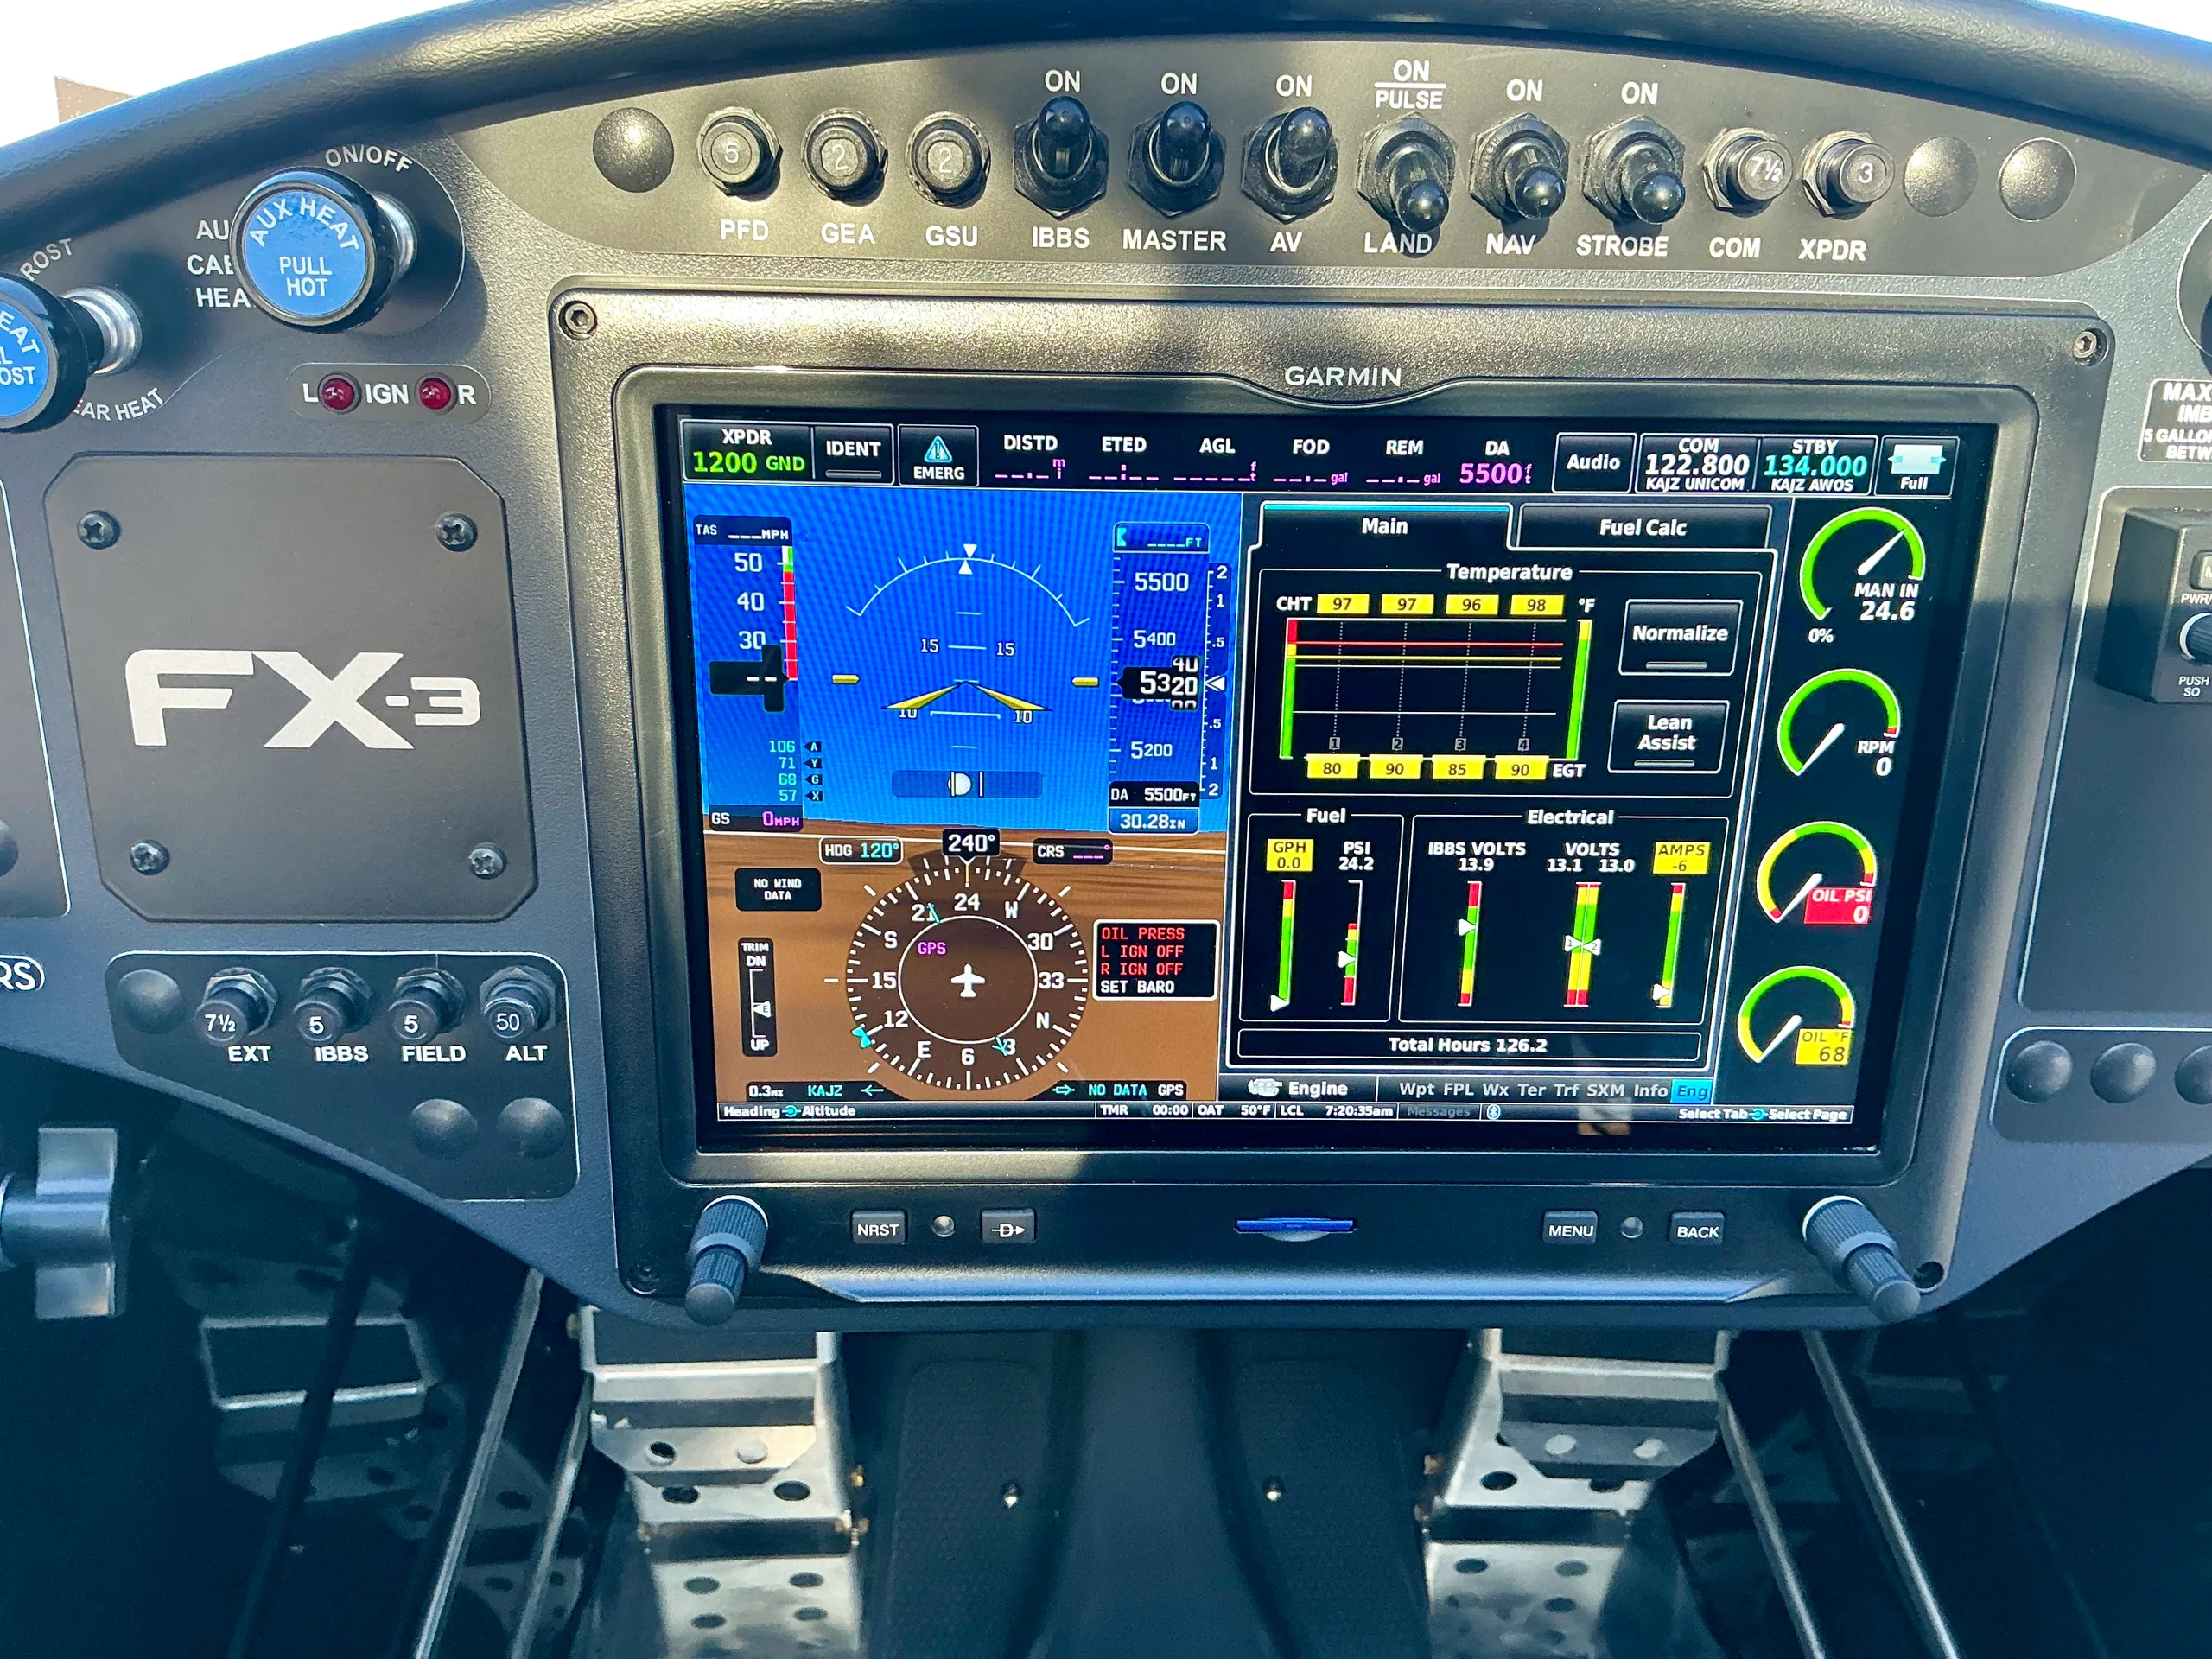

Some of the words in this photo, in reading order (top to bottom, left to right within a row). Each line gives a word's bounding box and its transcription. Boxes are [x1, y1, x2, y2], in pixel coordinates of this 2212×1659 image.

[1393, 60, 1431, 81] ON
[1045, 70, 1081, 92] ON
[1160, 73, 1198, 95] ON
[1275, 75, 1313, 97] ON
[1506, 79, 1543, 102] ON
[1621, 83, 1658, 105] ON
[1375, 90, 1443, 111] PULSE
[325, 145, 413, 173] ON/OFF
[724, 140, 740, 163] 5
[833, 146, 849, 171] 2
[1857, 162, 1874, 183] 3
[249, 198, 293, 247] AUX
[299, 197, 359, 251] HEAT
[720, 220, 769, 241] PFD
[821, 223, 875, 245] GEA
[925, 226, 978, 247] GSU
[1032, 227, 1090, 250] IBBS
[1122, 230, 1226, 251] MASTER
[1269, 232, 1303, 252] AV
[1363, 232, 1433, 254] LAND
[1486, 234, 1537, 256] NAV
[1576, 234, 1669, 257] STROBE
[1709, 237, 1761, 258] COM
[1799, 238, 1866, 260] XPDR
[279, 256, 332, 276] PULL
[286, 278, 328, 296] HOT
[1284, 366, 1402, 388] GARMIN
[302, 383, 319, 403] L
[365, 383, 408, 404] IGN
[457, 385, 476, 404] R
[115, 387, 163, 421] HEAT
[2144, 428, 2153, 442] 5
[721, 429, 772, 445] XPDR
[826, 441, 881, 457] IDENT
[1003, 435, 1058, 451] DISTD
[1102, 436, 1147, 452] ETED
[1199, 438, 1235, 454] AGL
[1292, 440, 1330, 454] FOD
[1386, 440, 1424, 454] REM
[1485, 441, 1510, 456] DA
[1678, 438, 1719, 454] COM
[1792, 439, 1839, 454] STBY
[693, 451, 757, 473] 1200
[766, 456, 805, 471] GND
[1567, 454, 1620, 470] Audio
[1645, 454, 1749, 475] 122.800
[1764, 455, 1867, 476] 134.000
[913, 466, 965, 480] EMERG
[1459, 463, 1522, 484] 5500
[1646, 478, 1681, 492] KAJZ
[1685, 478, 1745, 490] UNICOM
[1900, 477, 1928, 490] Full
[696, 524, 717, 535] TAS
[1362, 518, 1408, 534] Main
[1599, 518, 1642, 535] Fuel
[1646, 519, 1687, 536] Calc
[734, 553, 763, 572] 50
[1446, 563, 1573, 584] Temperature
[1854, 583, 1895, 597] MAN
[1900, 583, 1918, 598] IN
[1276, 596, 1312, 610] CHT
[1332, 598, 1351, 610] 97
[1462, 599, 1481, 611] 96
[1859, 601, 1915, 620] 24.6
[1134, 630, 1176, 648] 5400
[1632, 625, 1728, 641] Normalize
[2178, 676, 2209, 686] PUSH
[125, 649, 481, 750] FX-3
[1647, 715, 1692, 730] Lean
[1637, 735, 1697, 751] Assist
[1857, 741, 1896, 754] RPM
[1323, 763, 1342, 774] 80
[1385, 763, 1404, 774] 90
[1553, 764, 1586, 778] EGT
[1111, 788, 1128, 800] DA
[711, 812, 730, 824] GS
[1307, 808, 1346, 823] Fuel
[1527, 810, 1614, 825] Electrical
[825, 845, 852, 857] HDG
[1037, 845, 1064, 858] CRS
[1274, 842, 1306, 853] GPH
[1344, 842, 1370, 855] PSI
[1428, 842, 1465, 855] IBBS
[1471, 842, 1526, 856] VOLTS
[1565, 843, 1620, 856] VOLTS
[1658, 844, 1705, 855] AMPS
[1338, 857, 1374, 870] 24.2
[1459, 858, 1494, 871] 13.9
[753, 879, 768, 888] NO
[773, 879, 802, 888] WIND
[764, 890, 791, 901] DATA
[1812, 889, 1839, 902] OIL
[1845, 890, 1871, 902] PSI
[1102, 927, 1128, 940] OIL
[1138, 927, 1185, 940] PRESS
[742, 943, 769, 951] TRIM
[918, 942, 947, 955] GPS
[1101, 945, 1109, 957] L
[1120, 945, 1147, 957] IGN
[1156, 945, 1184, 957] OFF
[747, 956, 766, 966] DN
[1101, 981, 1128, 993] SET
[1137, 981, 1174, 993] BARO
[308, 1015, 325, 1035] 5
[496, 1013, 520, 1032] 50
[1389, 1037, 1433, 1052] Total
[1438, 1038, 1491, 1052] Hours
[1497, 1038, 1548, 1052] 126.2
[1802, 1032, 1827, 1042] OIL
[751, 1039, 769, 1051] UP
[229, 1045, 270, 1062] EXT
[315, 1046, 368, 1063] IBBS
[402, 1046, 467, 1062] FIELD
[505, 1046, 548, 1062] ALT
[1819, 1046, 1846, 1061] 68
[808, 1085, 842, 1096] KAJZ
[1089, 1084, 1106, 1096] NO
[1113, 1084, 1147, 1096] DATA
[1158, 1084, 1184, 1096] GPS
[1288, 1082, 1348, 1098] Engine
[1400, 1083, 1434, 1097] Wpt
[1444, 1083, 1474, 1096] FPL
[1483, 1084, 1509, 1096] Wx
[1517, 1084, 1546, 1096] Ter
[1554, 1084, 1580, 1097] Trf
[1586, 1084, 1624, 1097] SXM
[1633, 1084, 1669, 1097] Info
[1677, 1085, 1708, 1100] Eng
[723, 1106, 780, 1119] Heading
[802, 1106, 855, 1116] Altitude
[1100, 1104, 1128, 1116] TMR
[1153, 1104, 1188, 1116] 00:00
[1198, 1105, 1224, 1116] OAT
[1241, 1105, 1271, 1116] 50°F
[1281, 1105, 1304, 1116] LCL
[1325, 1105, 1393, 1116] 7:20:35am
[1408, 1105, 1470, 1118] Messages
[1679, 1108, 1720, 1119] Select
[1723, 1109, 1748, 1120] Tab
[1769, 1109, 1811, 1120] Select
[1813, 1109, 1847, 1122] Page
[857, 1224, 899, 1236] NRST
[1548, 1225, 1594, 1237] MENU
[1677, 1226, 1719, 1238] BACK
